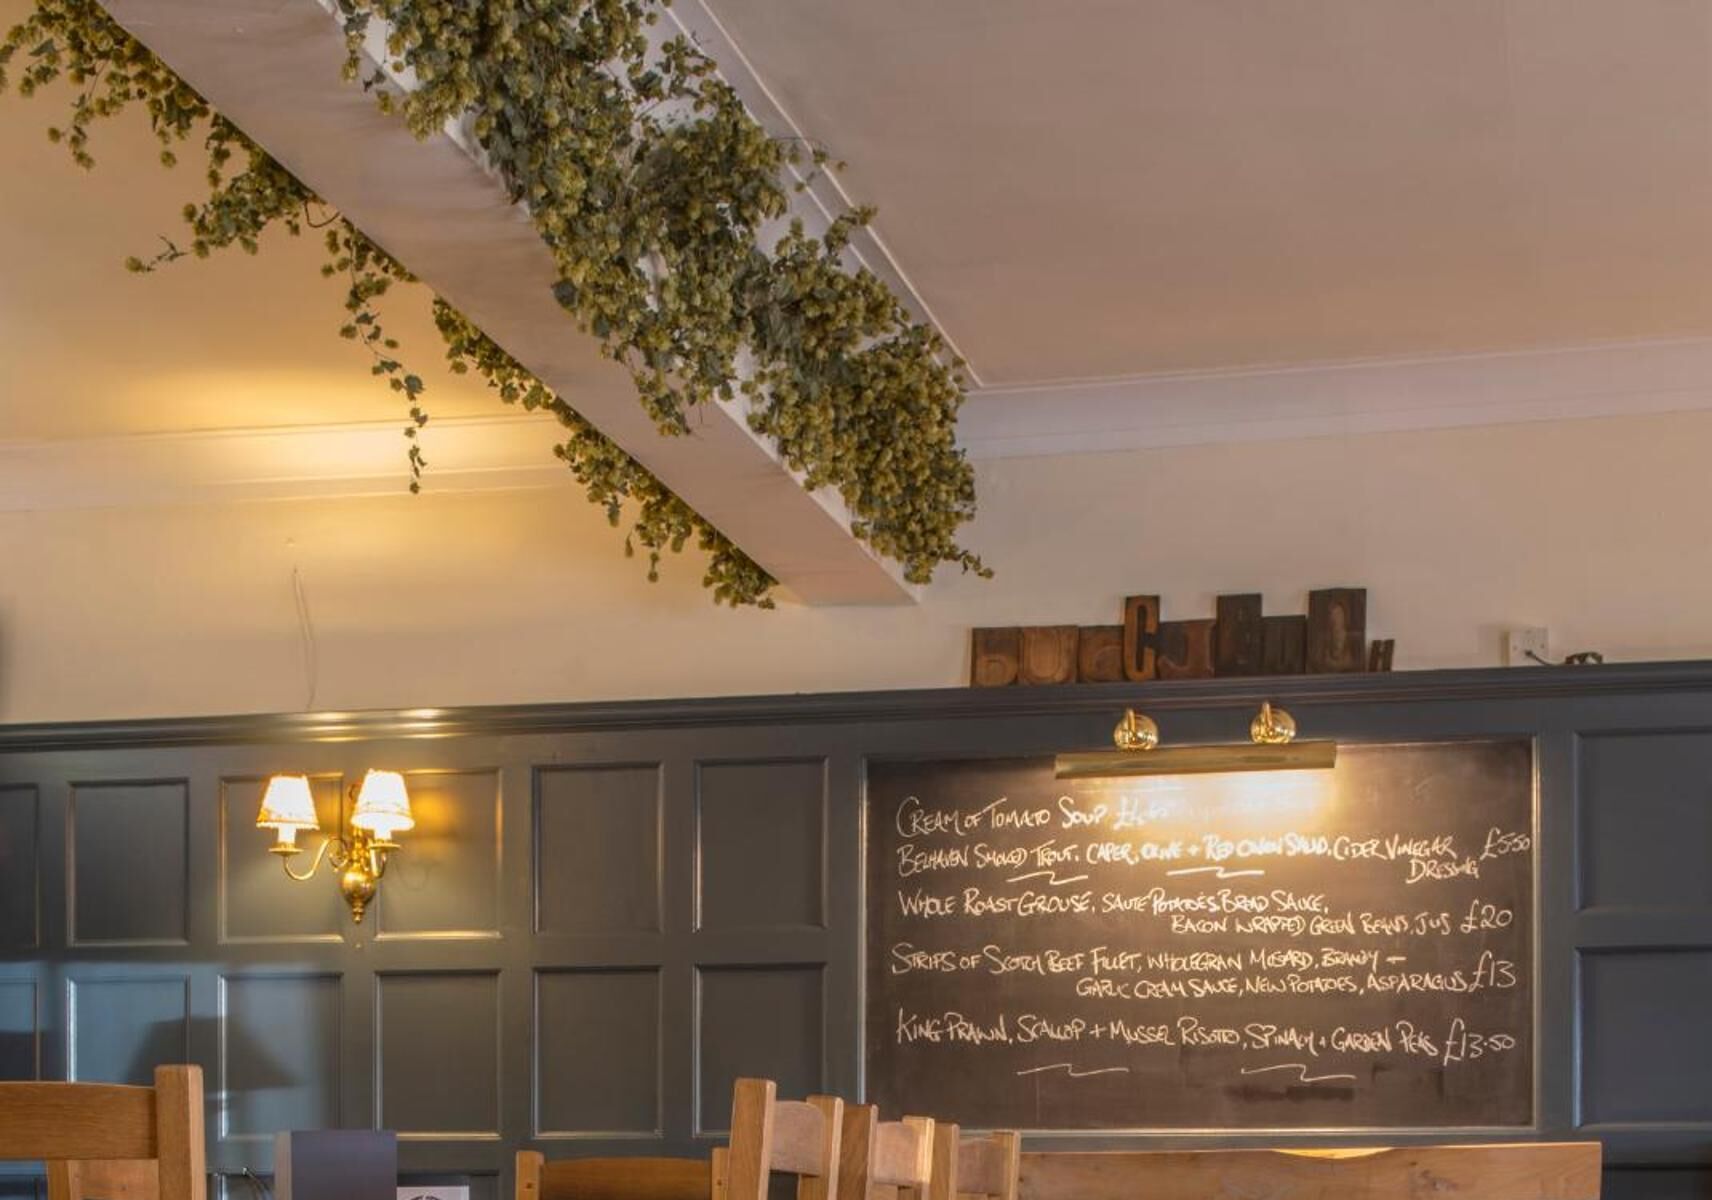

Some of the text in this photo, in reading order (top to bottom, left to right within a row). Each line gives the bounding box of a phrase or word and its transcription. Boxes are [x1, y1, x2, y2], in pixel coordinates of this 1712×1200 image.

[896, 797, 965, 837] CREAM
[979, 798, 1050, 828] TOMATO
[1059, 796, 1108, 828] SOUP
[1203, 834, 1234, 862] RED
[1333, 835, 1387, 860] CIDER
[1385, 833, 1458, 860] VINEGAR
[897, 888, 954, 918] WHOLE
[963, 887, 1017, 916] ROAST
[1170, 915, 1230, 934] BACON
[1309, 911, 1356, 936] GREEN
[1414, 911, 1452, 936] JUS
[1460, 899, 1514, 934] £20
[892, 942, 956, 975] STRIPS
[959, 953, 982, 970] OF
[1044, 949, 1086, 973] BEEF
[1076, 977, 1132, 999] GARLIC
[1133, 978, 1189, 999] CREAM
[1245, 975, 1289, 993] NEW
[1367, 970, 1468, 994] ASPARAGUS
[1467, 950, 1517, 993] £13
[896, 1008, 942, 1044] KING
[1016, 1014, 1086, 1043] SCALLOP
[1109, 1018, 1177, 1046] MUSSEL
[1330, 1026, 1393, 1053] GARDEN
